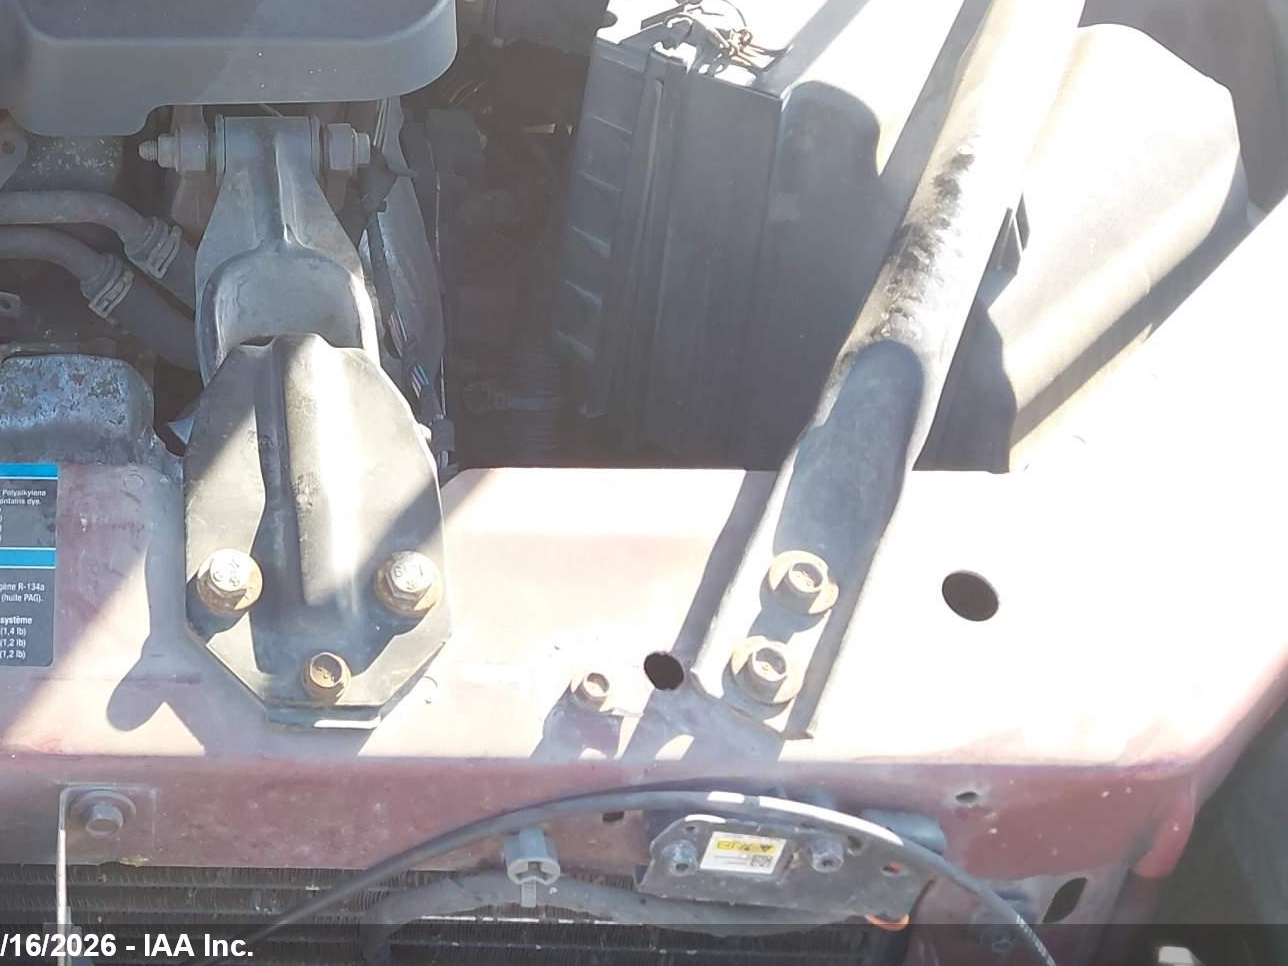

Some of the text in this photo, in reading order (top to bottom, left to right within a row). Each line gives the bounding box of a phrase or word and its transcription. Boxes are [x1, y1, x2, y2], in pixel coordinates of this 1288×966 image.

[1, 594, 22, 602] (huile
[0, 616, 32, 625] système
[17, 628, 26, 636] lb)
[16, 640, 26, 648] lb)
[16, 650, 26, 659] lb)
